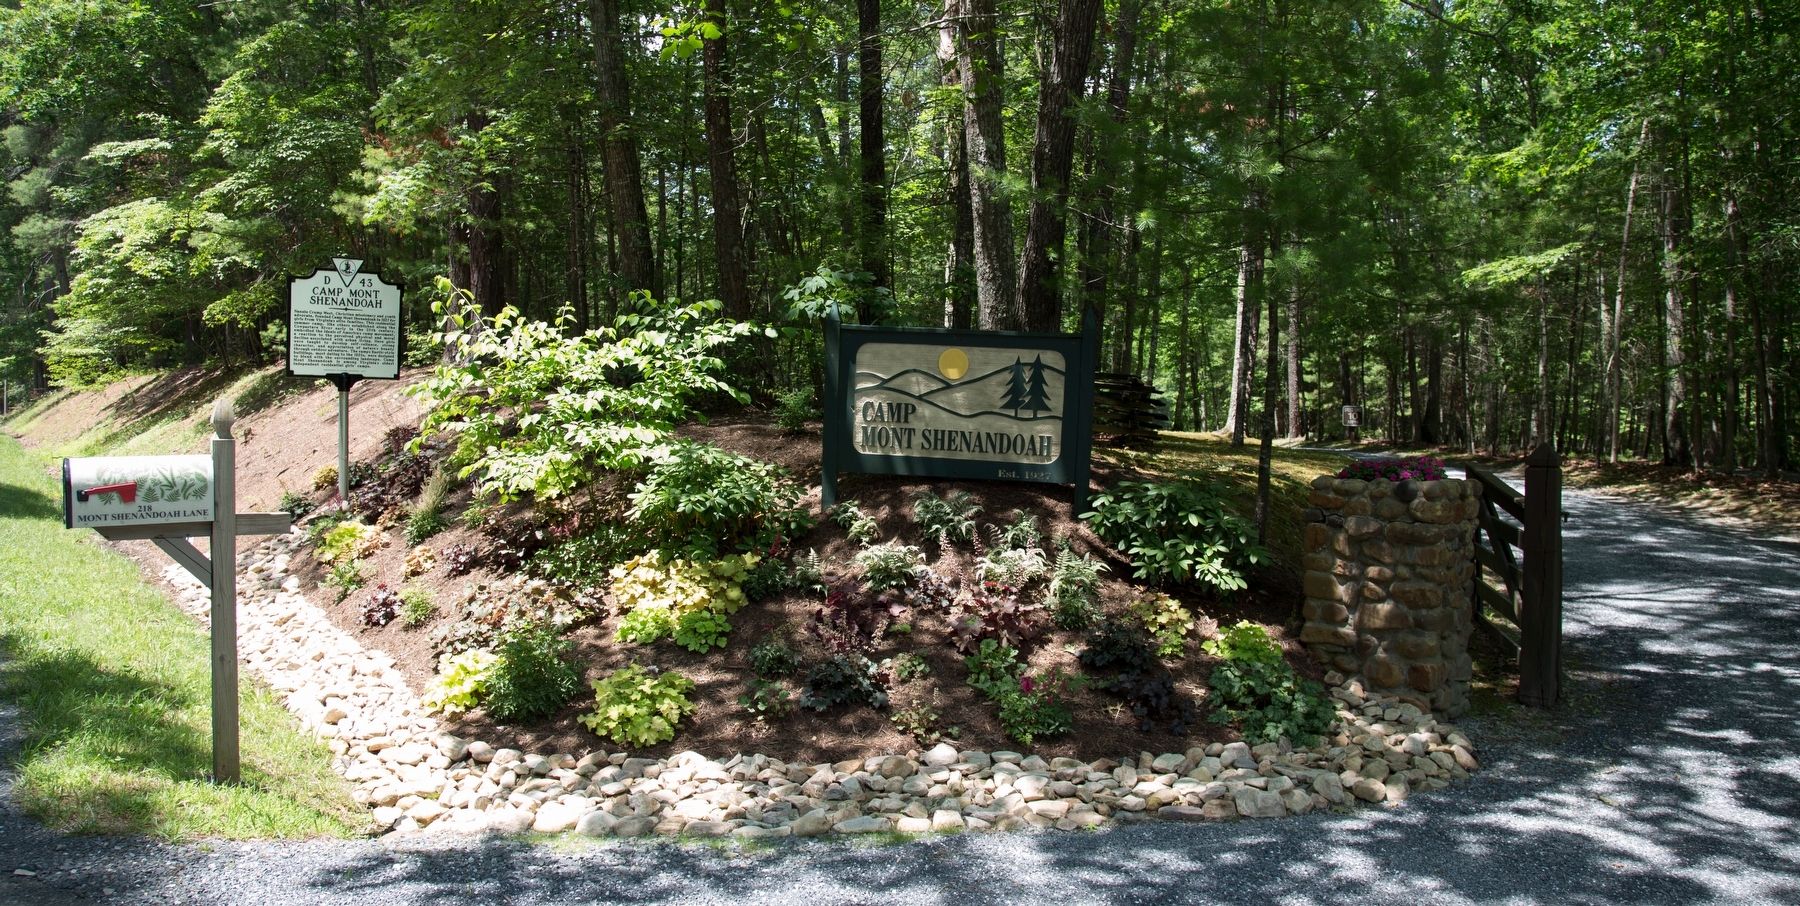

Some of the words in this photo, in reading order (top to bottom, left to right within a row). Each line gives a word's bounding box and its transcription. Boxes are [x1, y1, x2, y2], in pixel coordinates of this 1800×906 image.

[324, 276, 331, 284] D
[360, 279, 373, 288] 43
[312, 287, 343, 297] CAMP
[350, 290, 380, 299] MONT
[310, 296, 382, 308] SHENANDOAH
[862, 401, 916, 424] CAMP
[860, 426, 916, 449] MONT
[921, 428, 1052, 456] SHENANDOAH
[998, 470, 1020, 479] Est.
[1024, 471, 1052, 480] 1927
[78, 514, 108, 522] MONT
[112, 510, 180, 520] SHENANDOAH
[184, 508, 208, 517] LANE
